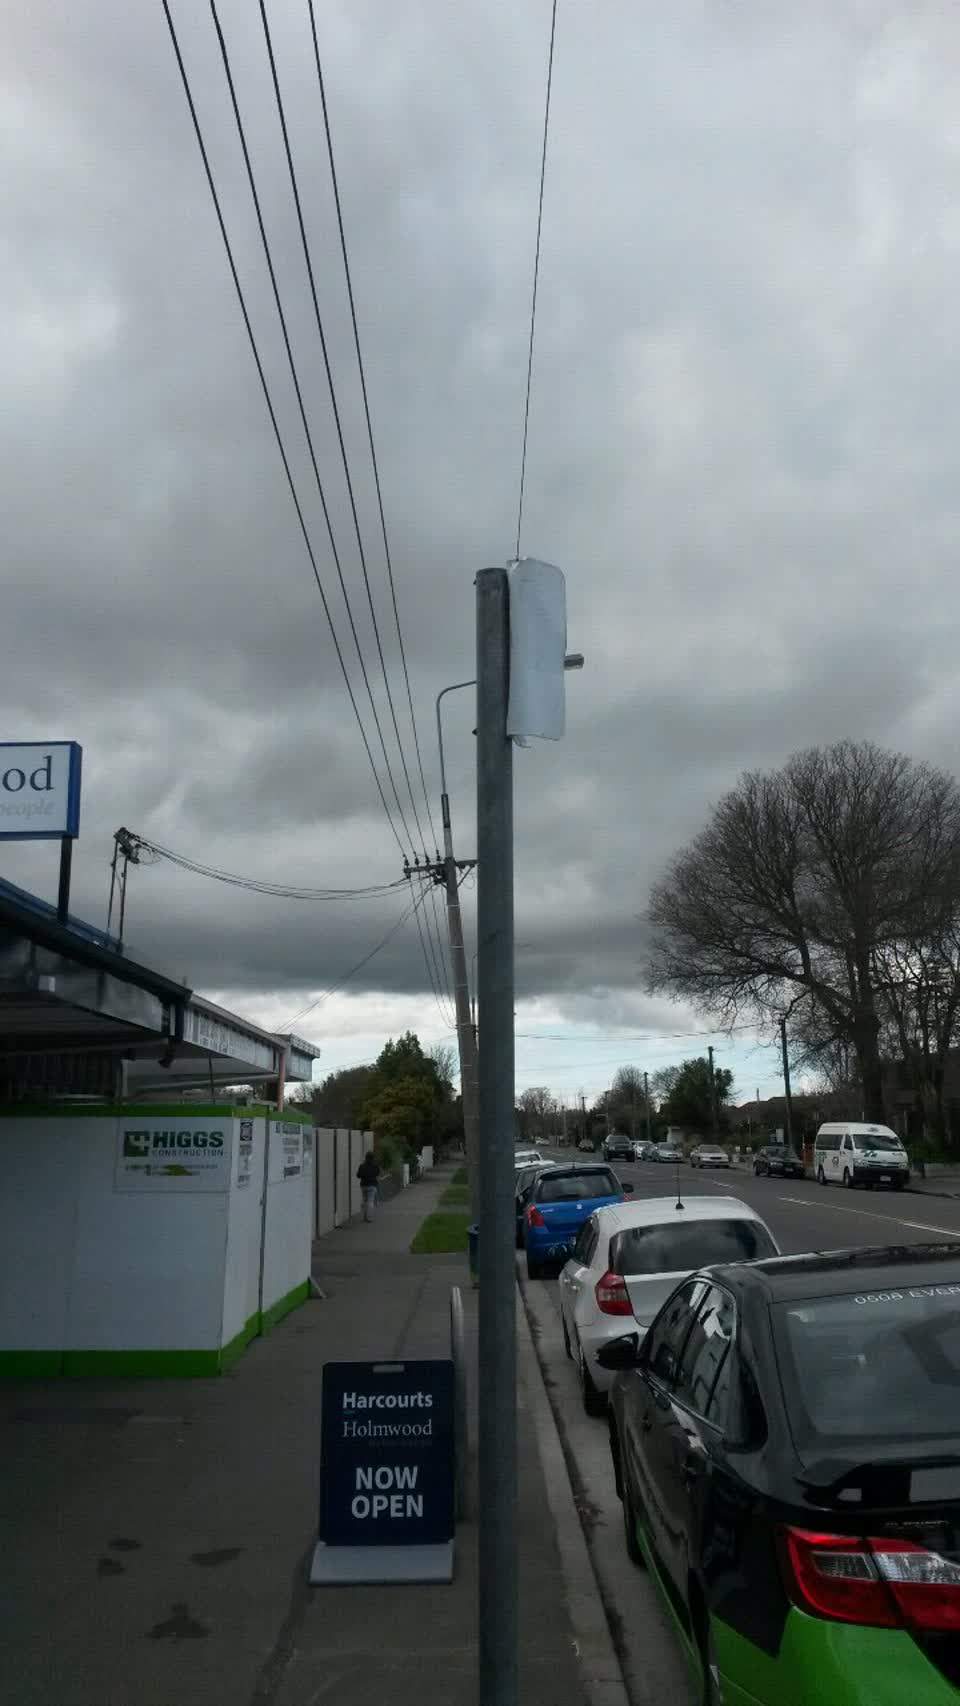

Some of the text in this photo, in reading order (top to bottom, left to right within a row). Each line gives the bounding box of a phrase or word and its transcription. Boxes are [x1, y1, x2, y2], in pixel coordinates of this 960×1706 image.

[152, 1131, 224, 1148] HIGGS
[152, 1149, 224, 1157] CONSTRUCTION
[343, 1391, 433, 1409] Harcourts
[343, 1419, 432, 1437] Holmwood
[355, 1466, 419, 1491] NOW
[351, 1494, 424, 1520] OPEN
